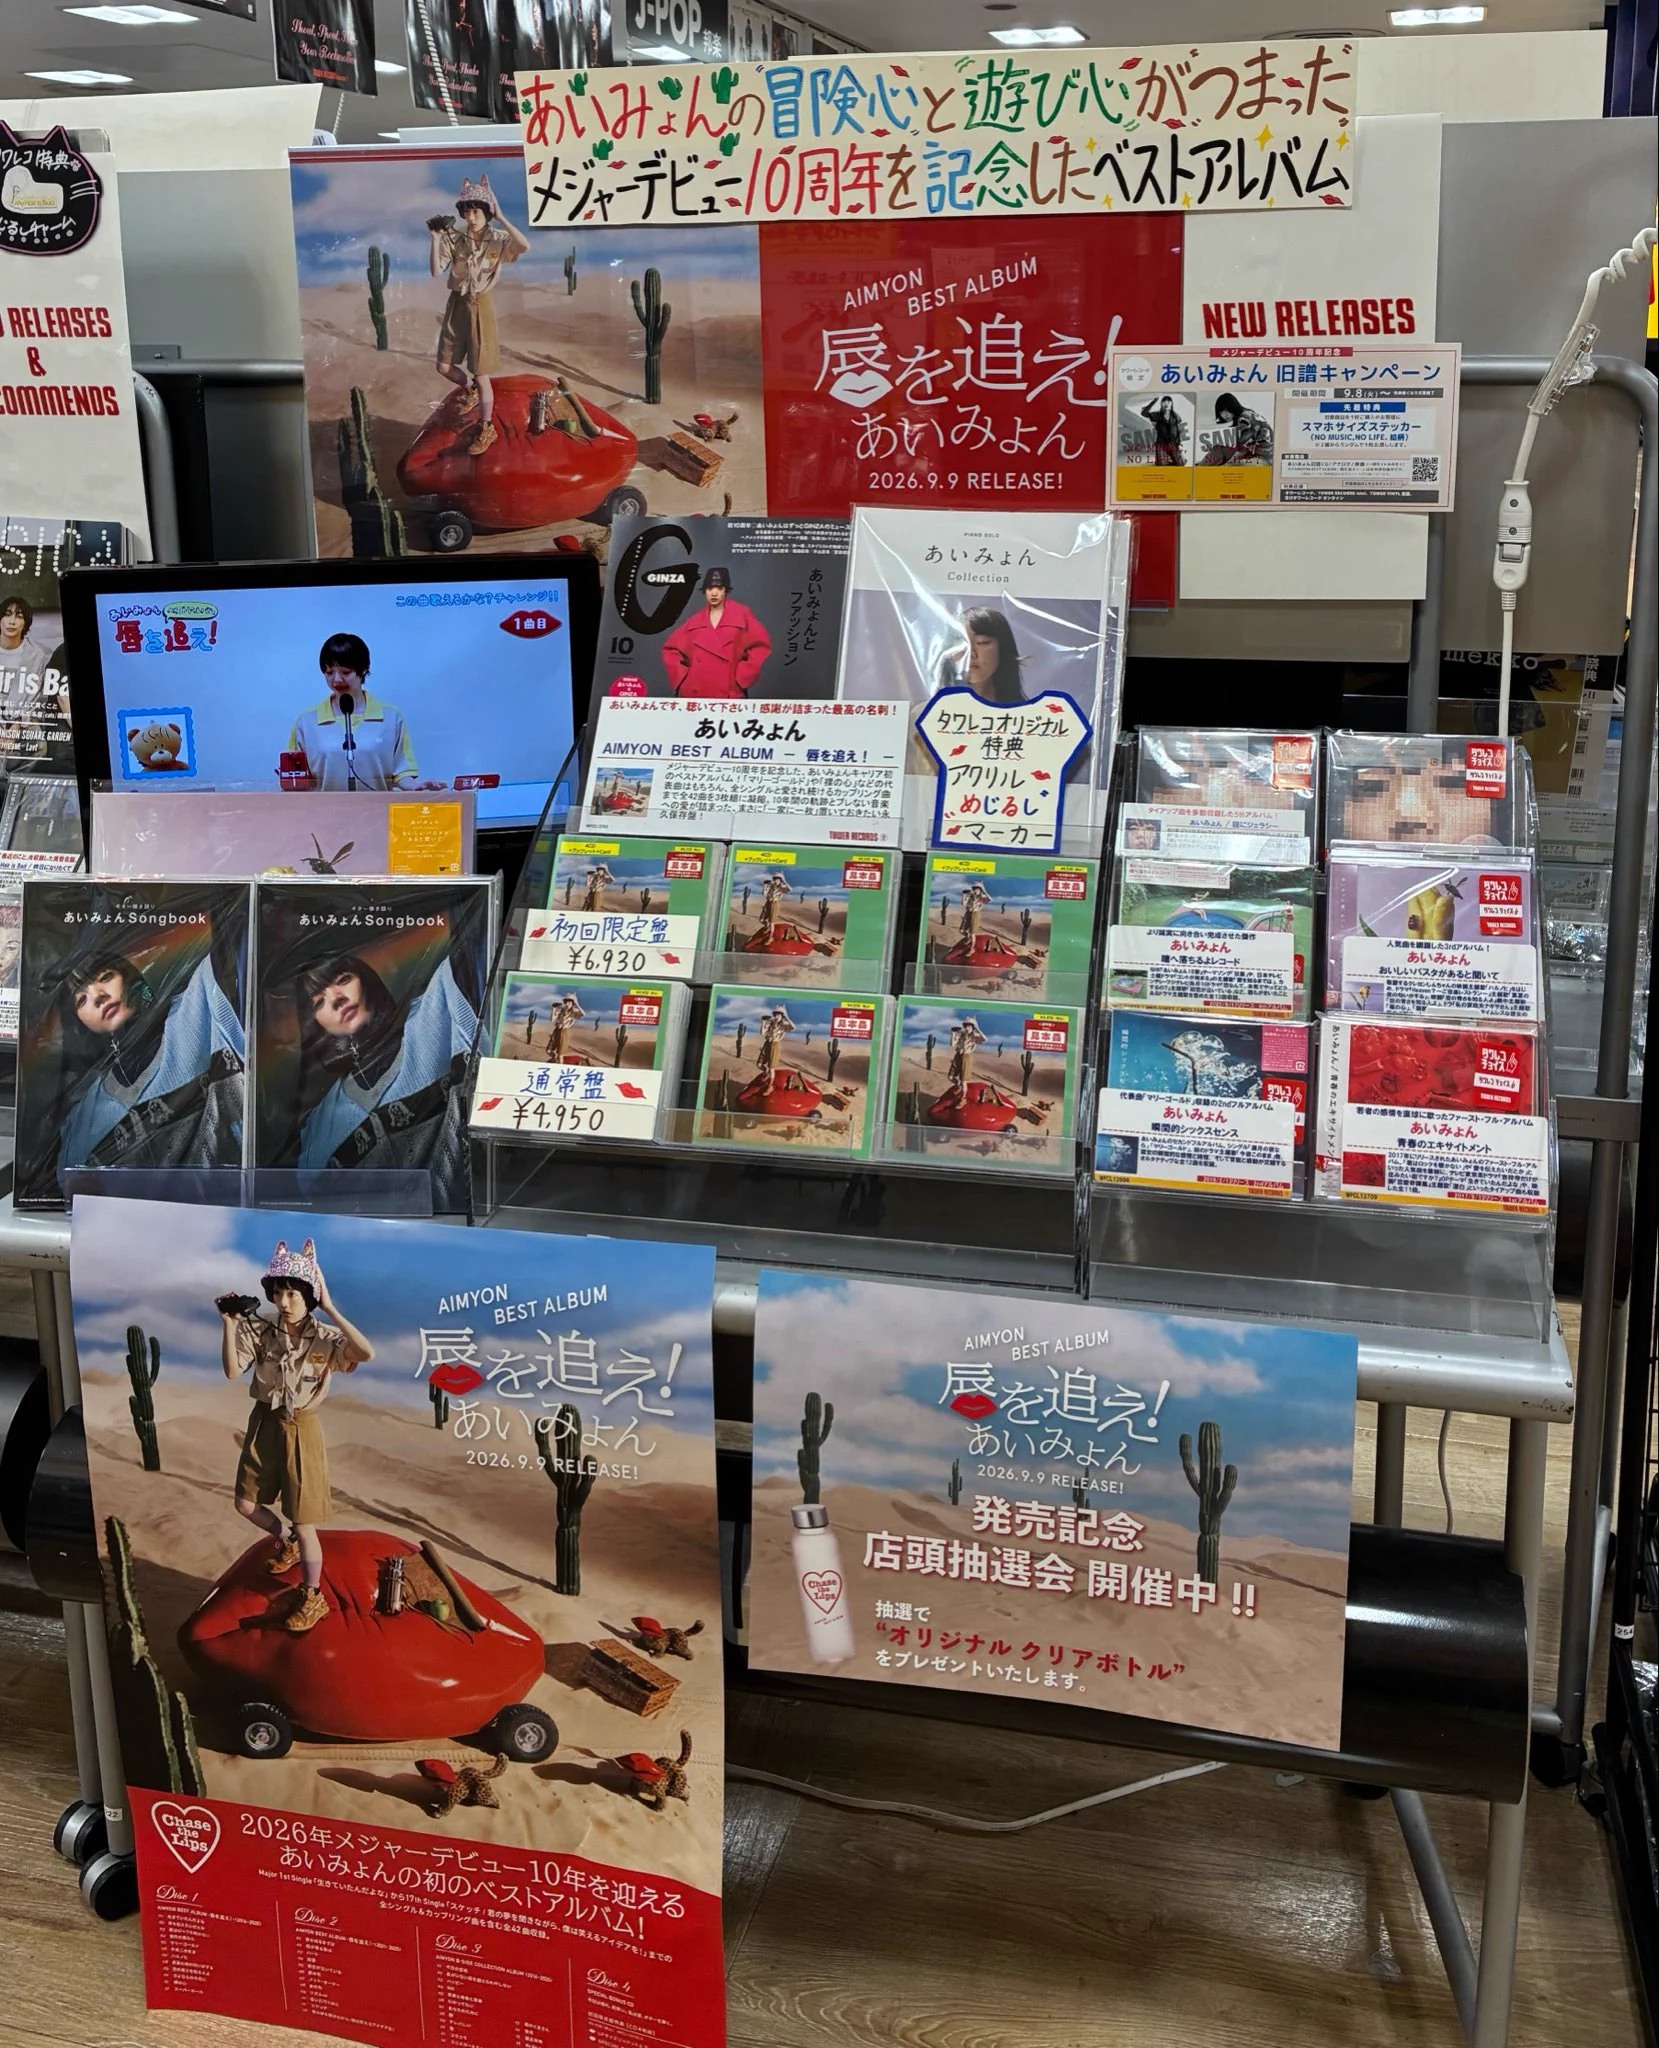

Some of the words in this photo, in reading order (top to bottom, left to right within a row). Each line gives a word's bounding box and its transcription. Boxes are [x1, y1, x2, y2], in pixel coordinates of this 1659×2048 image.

[0, 149, 71, 170] ワレコ特典
[533, 133, 1350, 223] メジャーデビュー10周年を記念したベストアルバム
[843, 267, 924, 311] AIMYON
[907, 283, 958, 316] BEST
[964, 256, 1038, 298] ALBUM
[7, 307, 112, 338] RELEASES
[1201, 301, 1268, 339] NEW
[1275, 297, 1416, 338] RELEASES
[26, 346, 47, 377] &
[1221, 347, 1342, 358] メジャーデビュー10周年記念
[1160, 363, 1268, 384] あいみょん
[1276, 363, 1441, 384] 旧譜キャンペーン
[1291, 389, 1327, 398] 開催期間
[851, 403, 1086, 460] あいみょん
[1301, 421, 1422, 432] スマホサイズステッカー
[868, 471, 960, 490] 2026.9.9
[967, 472, 1063, 490] RELEASE!
[924, 545, 1036, 567] あいみょん
[646, 573, 686, 584] GINZA
[947, 571, 1010, 584] Collection
[802, 568, 824, 651] あいみょんと
[513, 617, 547, 630] 1曲目
[783, 591, 804, 666] ファッション
[115, 619, 218, 653] 唇を追え!
[610, 636, 635, 655] 10
[19, 666, 41, 695] is
[693, 717, 807, 742] あいみょん
[937, 709, 1070, 735] タワレコオリジナル
[602, 741, 663, 757] AIMYON
[670, 743, 712, 759] BEST
[719, 746, 774, 761] ALBUM
[805, 748, 868, 763] 唇を追え！
[980, 735, 1024, 758] 特典
[1471, 748, 1494, 758] タワレコ
[1471, 758, 1494, 767] チョイス
[948, 764, 1026, 789] アクリル
[959, 793, 1040, 817] めじるし
[965, 823, 1054, 845] マーカー
[1188, 819, 1223, 828] あいみょん
[829, 830, 850, 841] TOWER
[850, 831, 878, 842] RECORDS
[1483, 880, 1508, 891] タワレコ
[1483, 890, 1508, 901] チョイス
[550, 912, 670, 944] 初回限定盤
[1170, 939, 1231, 954] あいみょん
[568, 945, 646, 973] ¥6,930
[1161, 954, 1241, 966] 瞳へ落ちるよレコード
[1407, 951, 1471, 966] あいみょん
[1379, 966, 1500, 980] おいしいパスタがあると聞いて
[1481, 1048, 1507, 1062] タワレコ
[1480, 1059, 1506, 1073] チョイス
[519, 1067, 607, 1100] 通常盤
[1267, 1084, 1292, 1096] タワレコ
[1119, 1091, 1274, 1111] 代表曲「マリーゴールド」収録の2ndフルアルバム
[512, 1097, 605, 1131] ¥4,950
[1163, 1106, 1228, 1124] あいみょん
[1356, 1106, 1534, 1127] 若者の感情を直球に歌ったファースト・フル・アルバム
[1151, 1122, 1239, 1138] 瞬間的シックスセンス
[1410, 1121, 1478, 1139] あいみょん
[1397, 1137, 1492, 1154] 青春のエキサイトメント
[438, 1284, 508, 1315] AIMYON
[494, 1300, 538, 1326] BEST
[543, 1284, 608, 1316] ALBUM
[964, 1326, 1025, 1352] AIMYON
[1011, 1341, 1049, 1362] BEST
[1054, 1330, 1110, 1355] ALBUM
[448, 1399, 656, 1457] あいみょん
[964, 1422, 1142, 1476] あいみょん
[466, 1450, 546, 1471] 2026.9.9
[553, 1456, 639, 1481] RELEASE!
[976, 1463, 1047, 1485] 2026.9.9
[1051, 1472, 1125, 1496] RELEASE!
[971, 1493, 1145, 1553] 発売記念
[861, 1530, 1076, 1595] 店頭抽選会
[1086, 1558, 1217, 1615] 開催中
[808, 1579, 837, 1589] Chase
[813, 1592, 836, 1601] Lips
[875, 1600, 931, 1623] 抽選で
[875, 1649, 1088, 1693] をプレゼントいたします。
[160, 1812, 212, 1832] Chase
[170, 1833, 209, 1853] Lips
[177, 1827, 199, 1839] the
[240, 1813, 686, 1919] 2026年メジャーデビュー10年を迎える
[258, 1868, 278, 1878] Major
[156, 1884, 188, 1900] Disc
[280, 1844, 645, 1940] あいみょんの初のベストアルバム!
[294, 1907, 326, 1923] Disc
[329, 1916, 338, 1926] 2
[435, 1933, 468, 1951] Disc
[471, 1943, 482, 1954] 3
[586, 1968, 619, 1988] Disc
